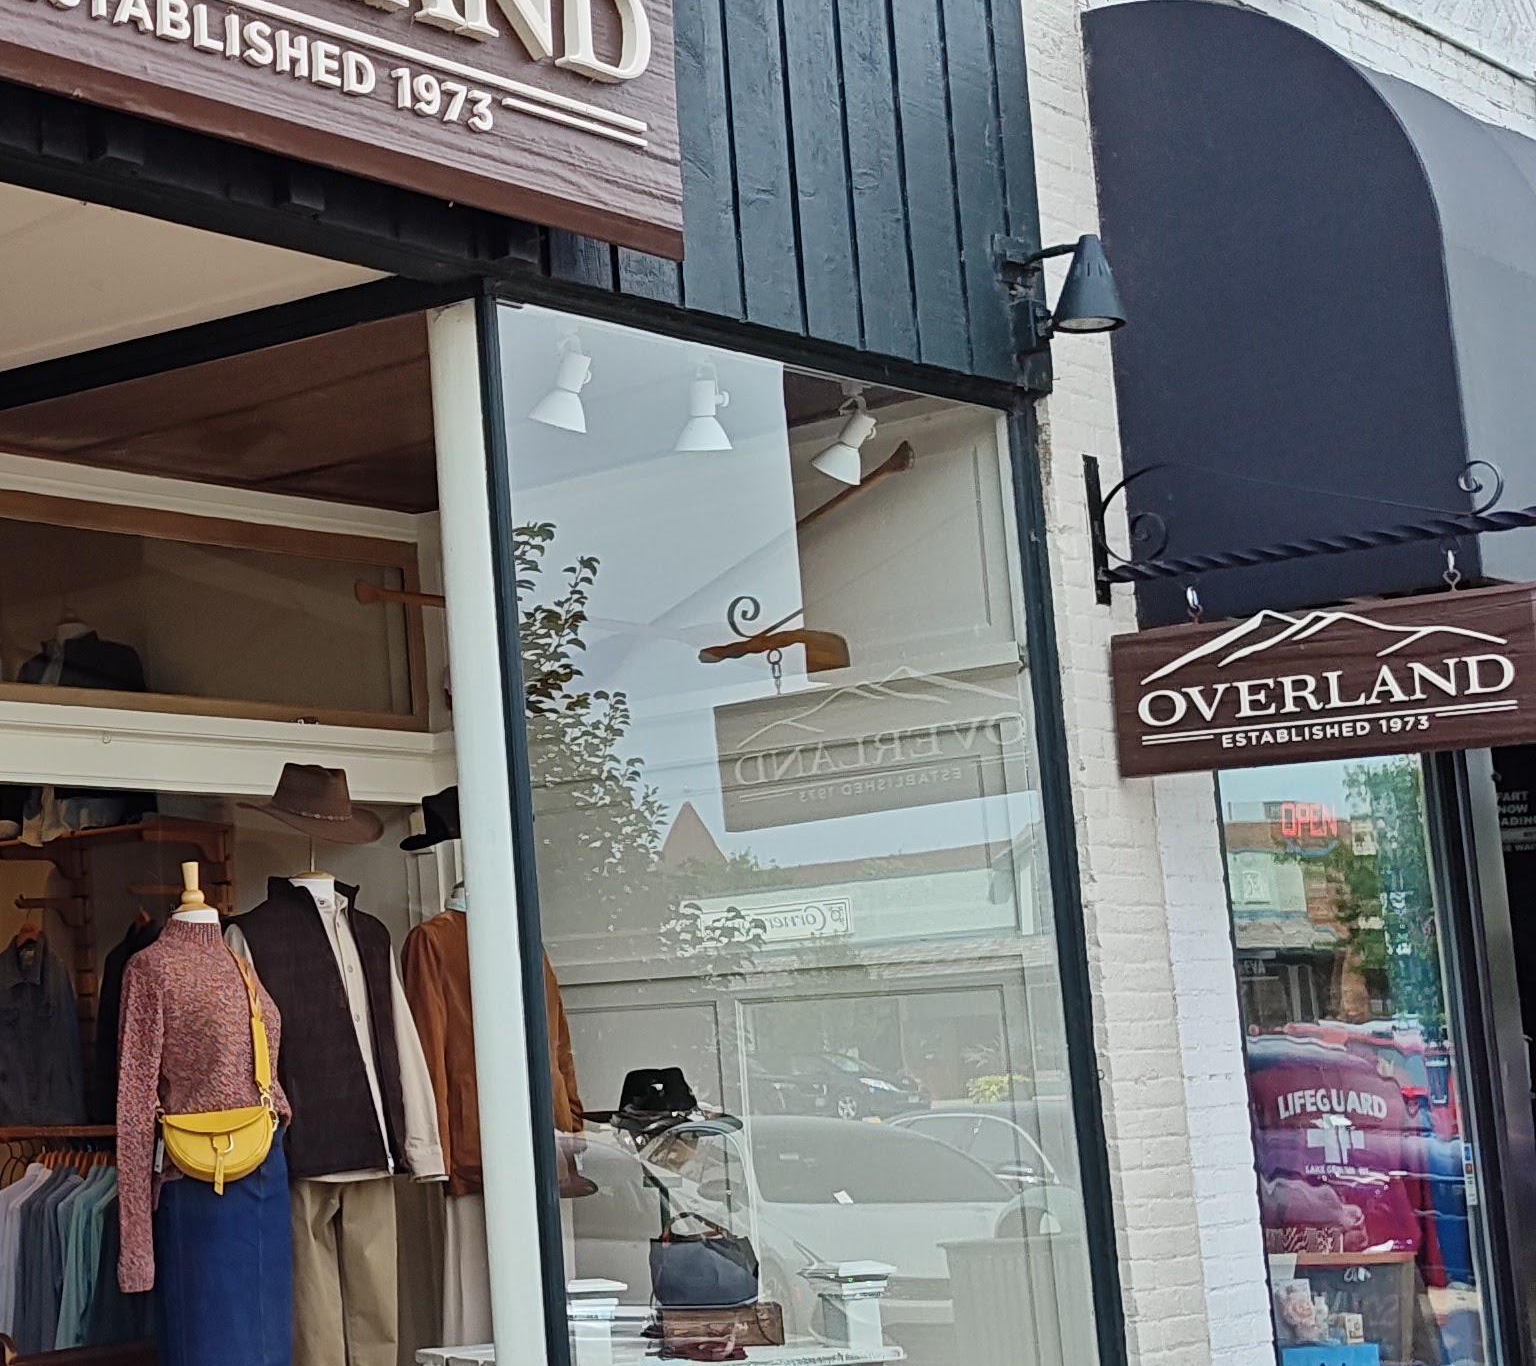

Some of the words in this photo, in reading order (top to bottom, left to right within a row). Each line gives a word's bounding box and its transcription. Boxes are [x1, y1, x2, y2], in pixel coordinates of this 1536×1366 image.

[390, 65, 495, 134] 1973
[1137, 653, 1516, 728] OVERLAND
[1221, 718, 1372, 750] ESTABLISHED
[1379, 715, 1431, 733] 1973
[1281, 801, 1338, 838] OPEN
[1277, 1088, 1388, 1120] LIFEGUARD
